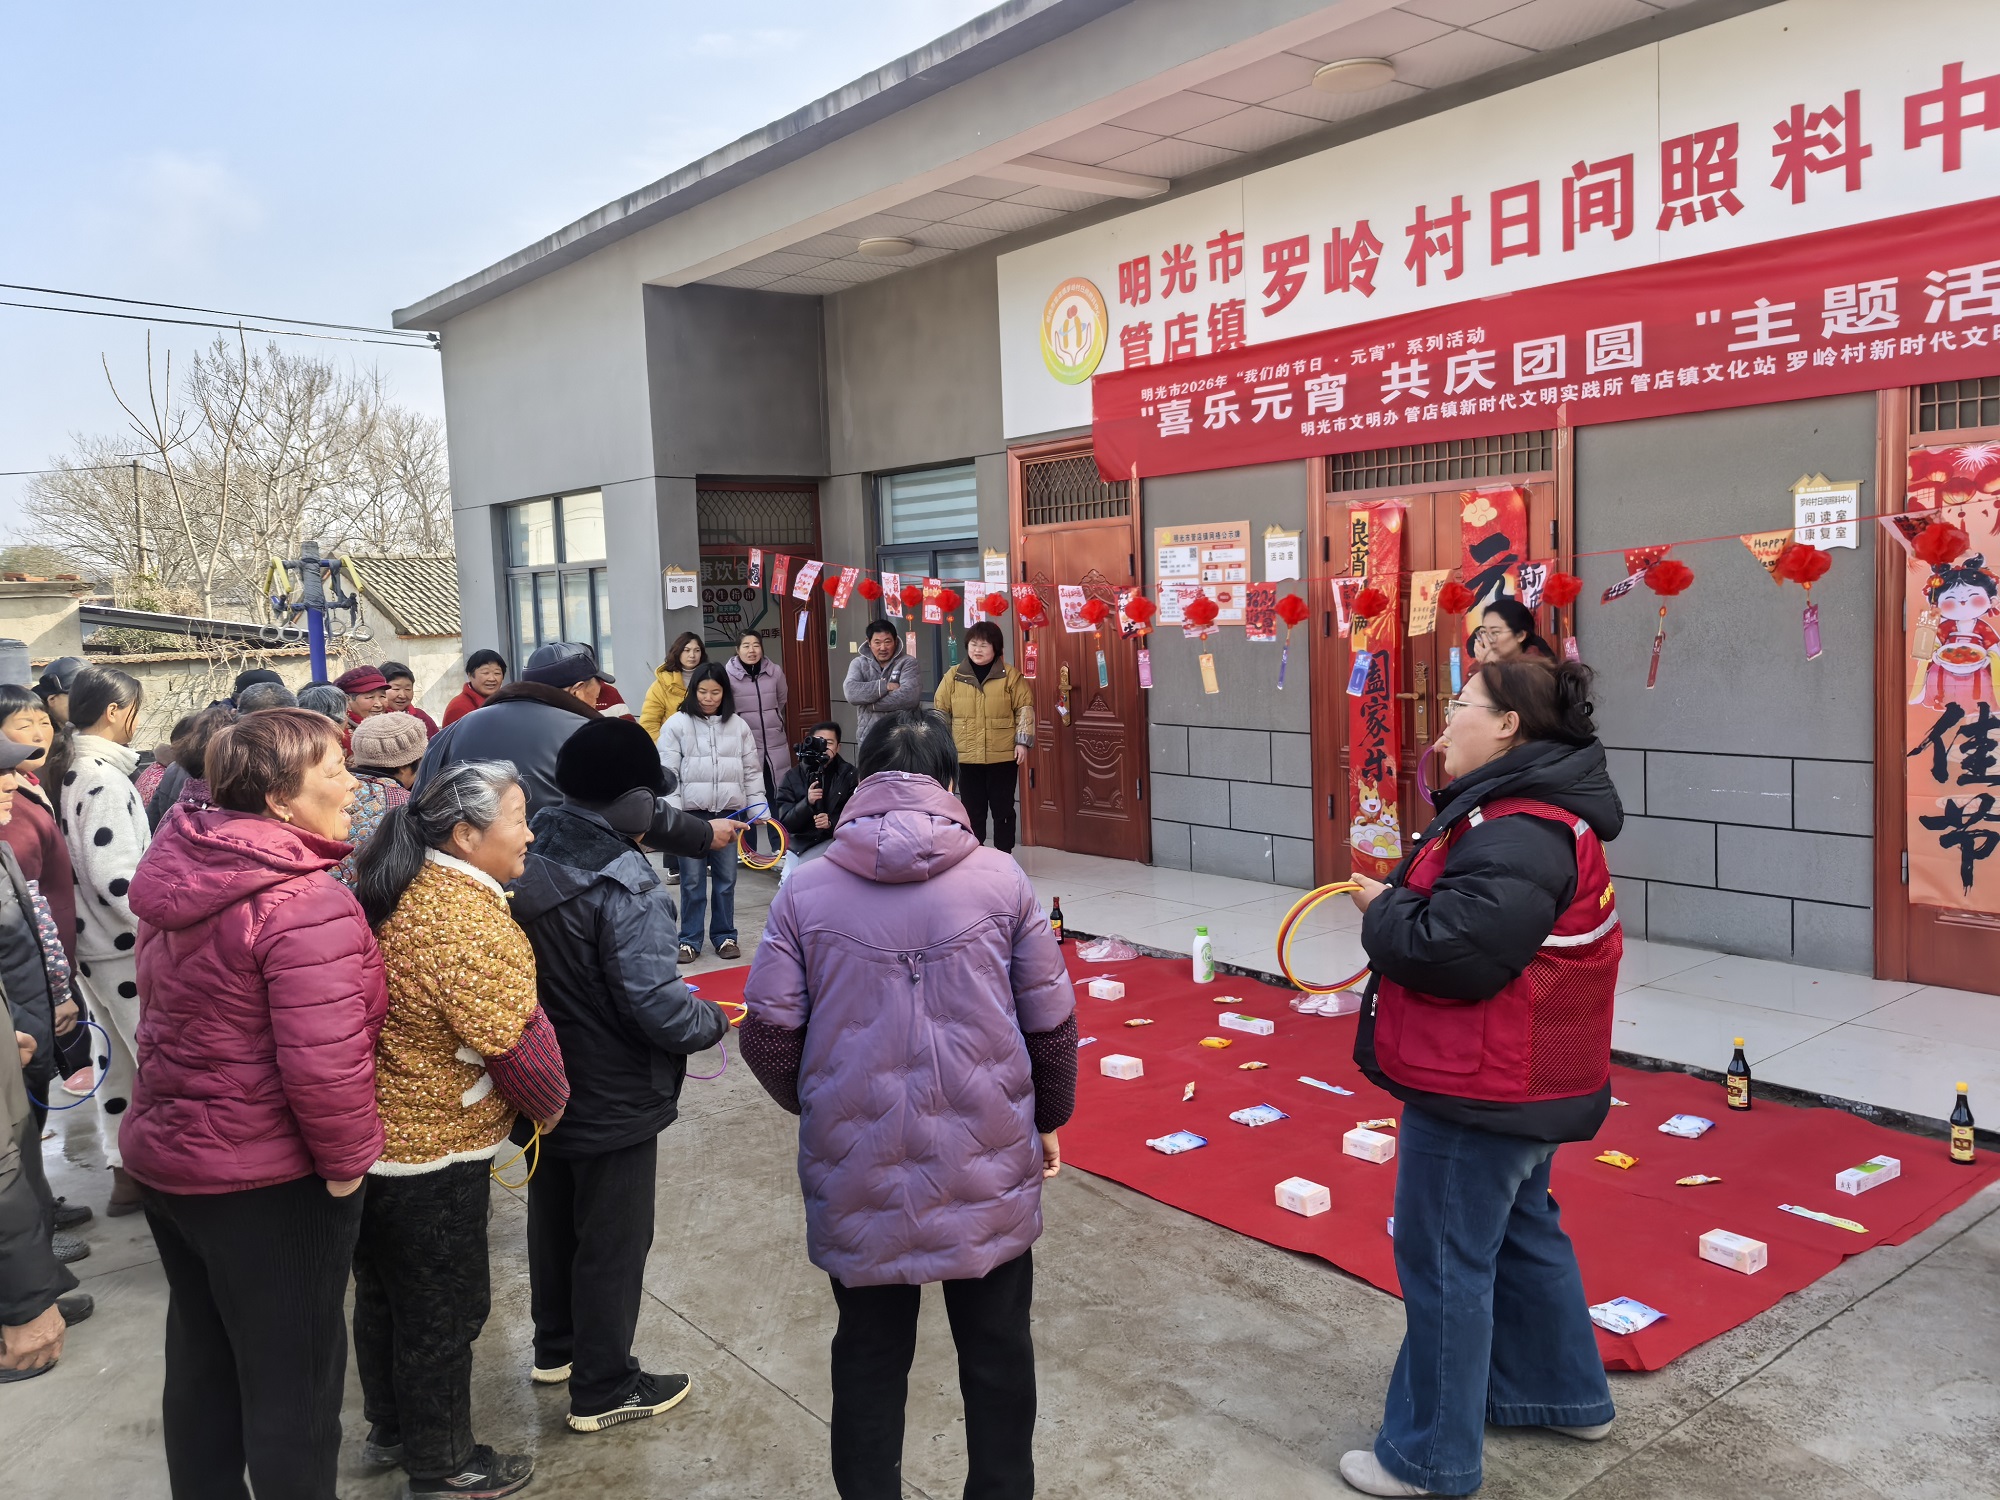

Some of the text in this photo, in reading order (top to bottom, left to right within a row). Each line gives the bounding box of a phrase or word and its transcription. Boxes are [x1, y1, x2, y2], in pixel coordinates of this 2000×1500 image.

[1119, 229, 1245, 308] 明光市
[1119, 298, 1247, 371] 管店镇
[1141, 375, 1228, 402] 明光市2026年
[1406, 326, 1485, 355] 系列活动
[1380, 321, 1643, 405] 共庆团圆
[1300, 322, 2000, 437] 明光市文明办 管店镇新时代文明实践所 管店镇文化站 罗岭村新时代文
[1804, 510, 1847, 524] 阅读室
[1804, 527, 1847, 541] 康复室
[761, 628, 780, 639] 四季
